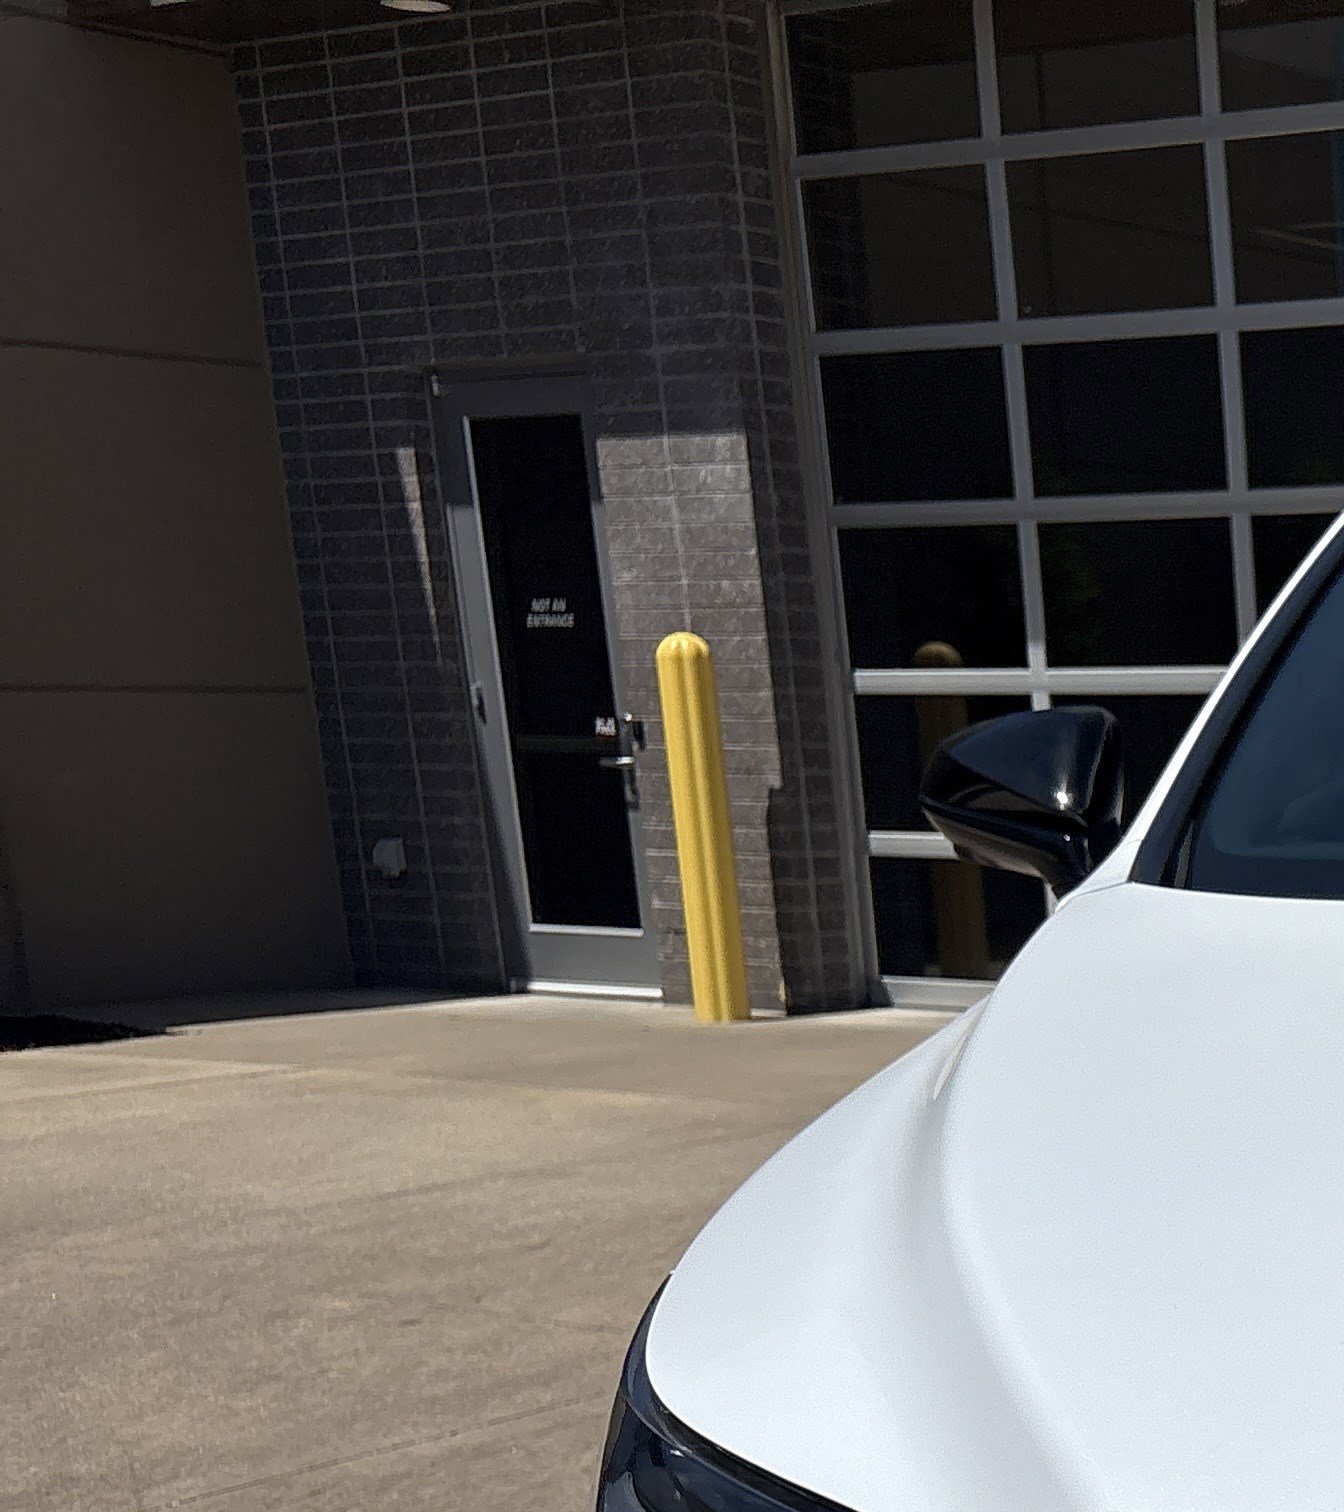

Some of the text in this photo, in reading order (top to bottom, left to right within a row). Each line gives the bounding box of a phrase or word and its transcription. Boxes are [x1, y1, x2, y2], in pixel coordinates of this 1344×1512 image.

[531, 597, 566, 612] NOT AN
[527, 613, 575, 628] ENTRANCE
